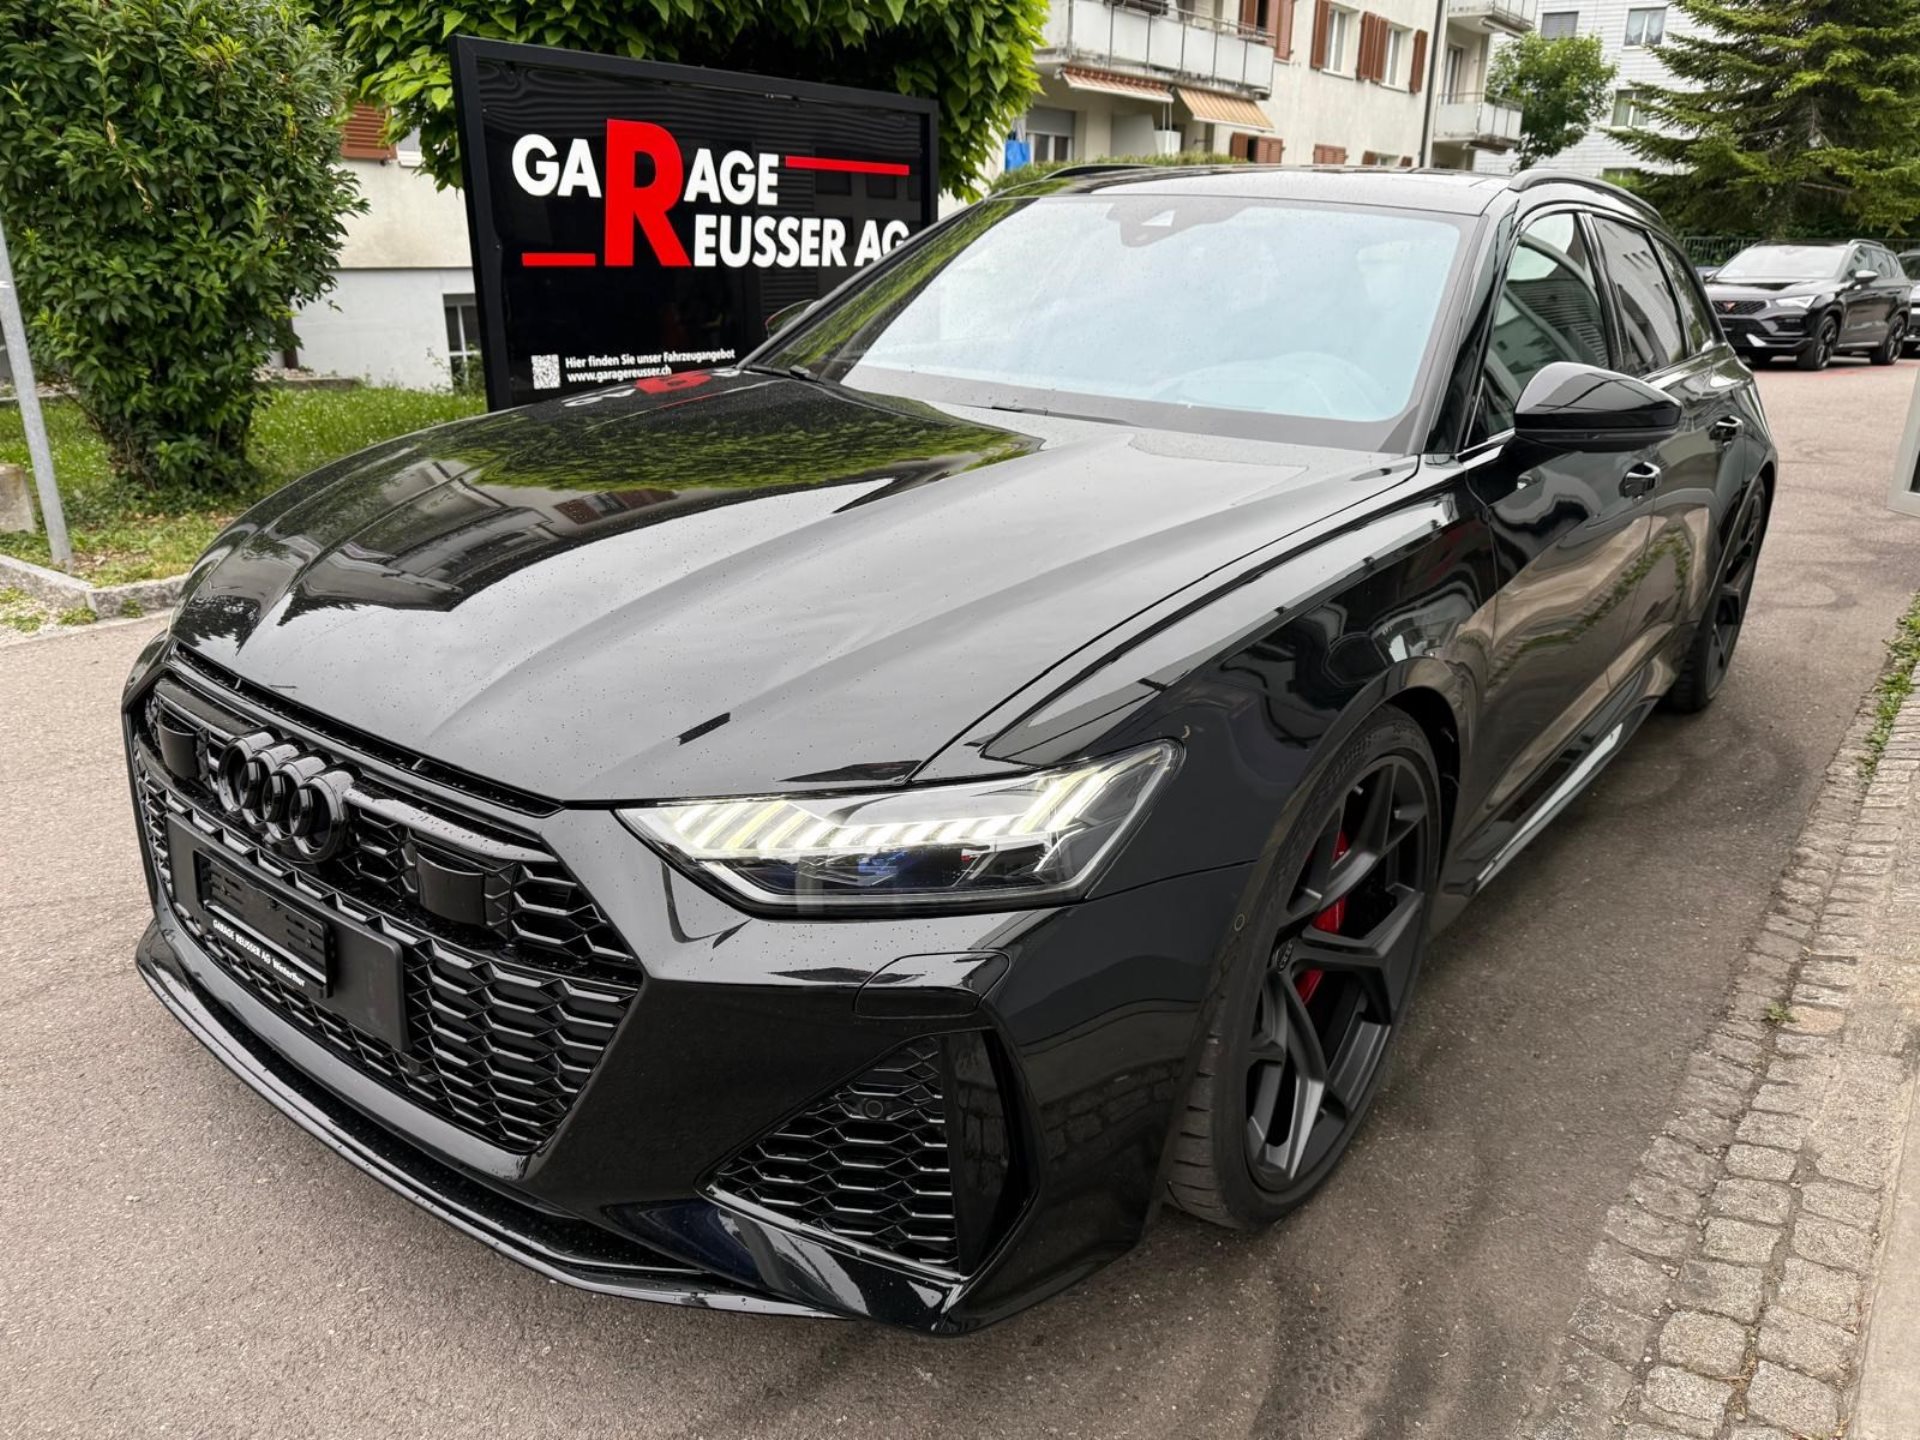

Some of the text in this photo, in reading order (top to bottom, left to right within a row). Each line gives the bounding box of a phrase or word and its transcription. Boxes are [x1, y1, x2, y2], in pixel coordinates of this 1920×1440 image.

[511, 118, 779, 266] GARAGE
[854, 219, 910, 266] AG
[565, 348, 735, 369] Hier finden Sie unser Fahrzeugangebot
[567, 365, 672, 383] www.garagereusser.ch
[213, 919, 235, 940] GARAGE
[261, 951, 271, 964] AG
